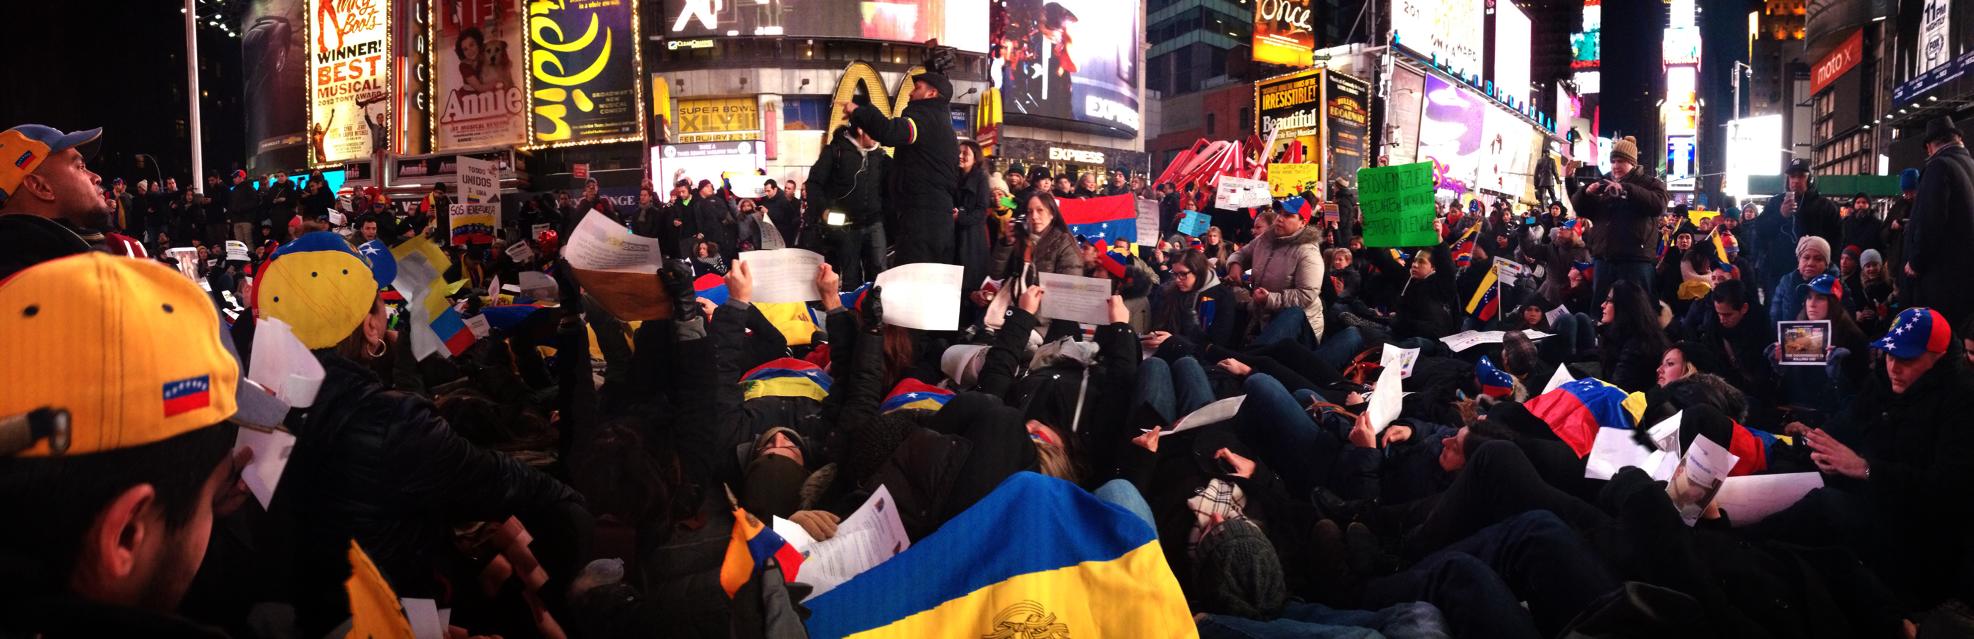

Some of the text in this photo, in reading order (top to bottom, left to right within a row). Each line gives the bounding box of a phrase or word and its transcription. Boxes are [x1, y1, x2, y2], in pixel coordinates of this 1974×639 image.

[343, 8, 382, 35] Boots
[1261, 0, 1312, 31] Once
[317, 40, 382, 65] WINNER!
[1929, 38, 1940, 50] FOX
[317, 55, 382, 86] BEST
[1817, 55, 1844, 85] moto
[317, 79, 381, 98] MUSICAL
[336, 94, 354, 103] TONY
[355, 91, 382, 101] AWARD
[1262, 85, 1317, 111] IRRESISTIBLE!
[440, 82, 523, 124] Annie
[679, 105, 758, 115] SUPER BOWL
[1262, 108, 1317, 133] Beautiful
[1329, 106, 1365, 123] BROADWAY
[1049, 147, 1104, 164] EXPRESS
[401, 161, 428, 177] Annie
[462, 174, 492, 188] UNIDOS
[450, 204, 465, 216] SOS
